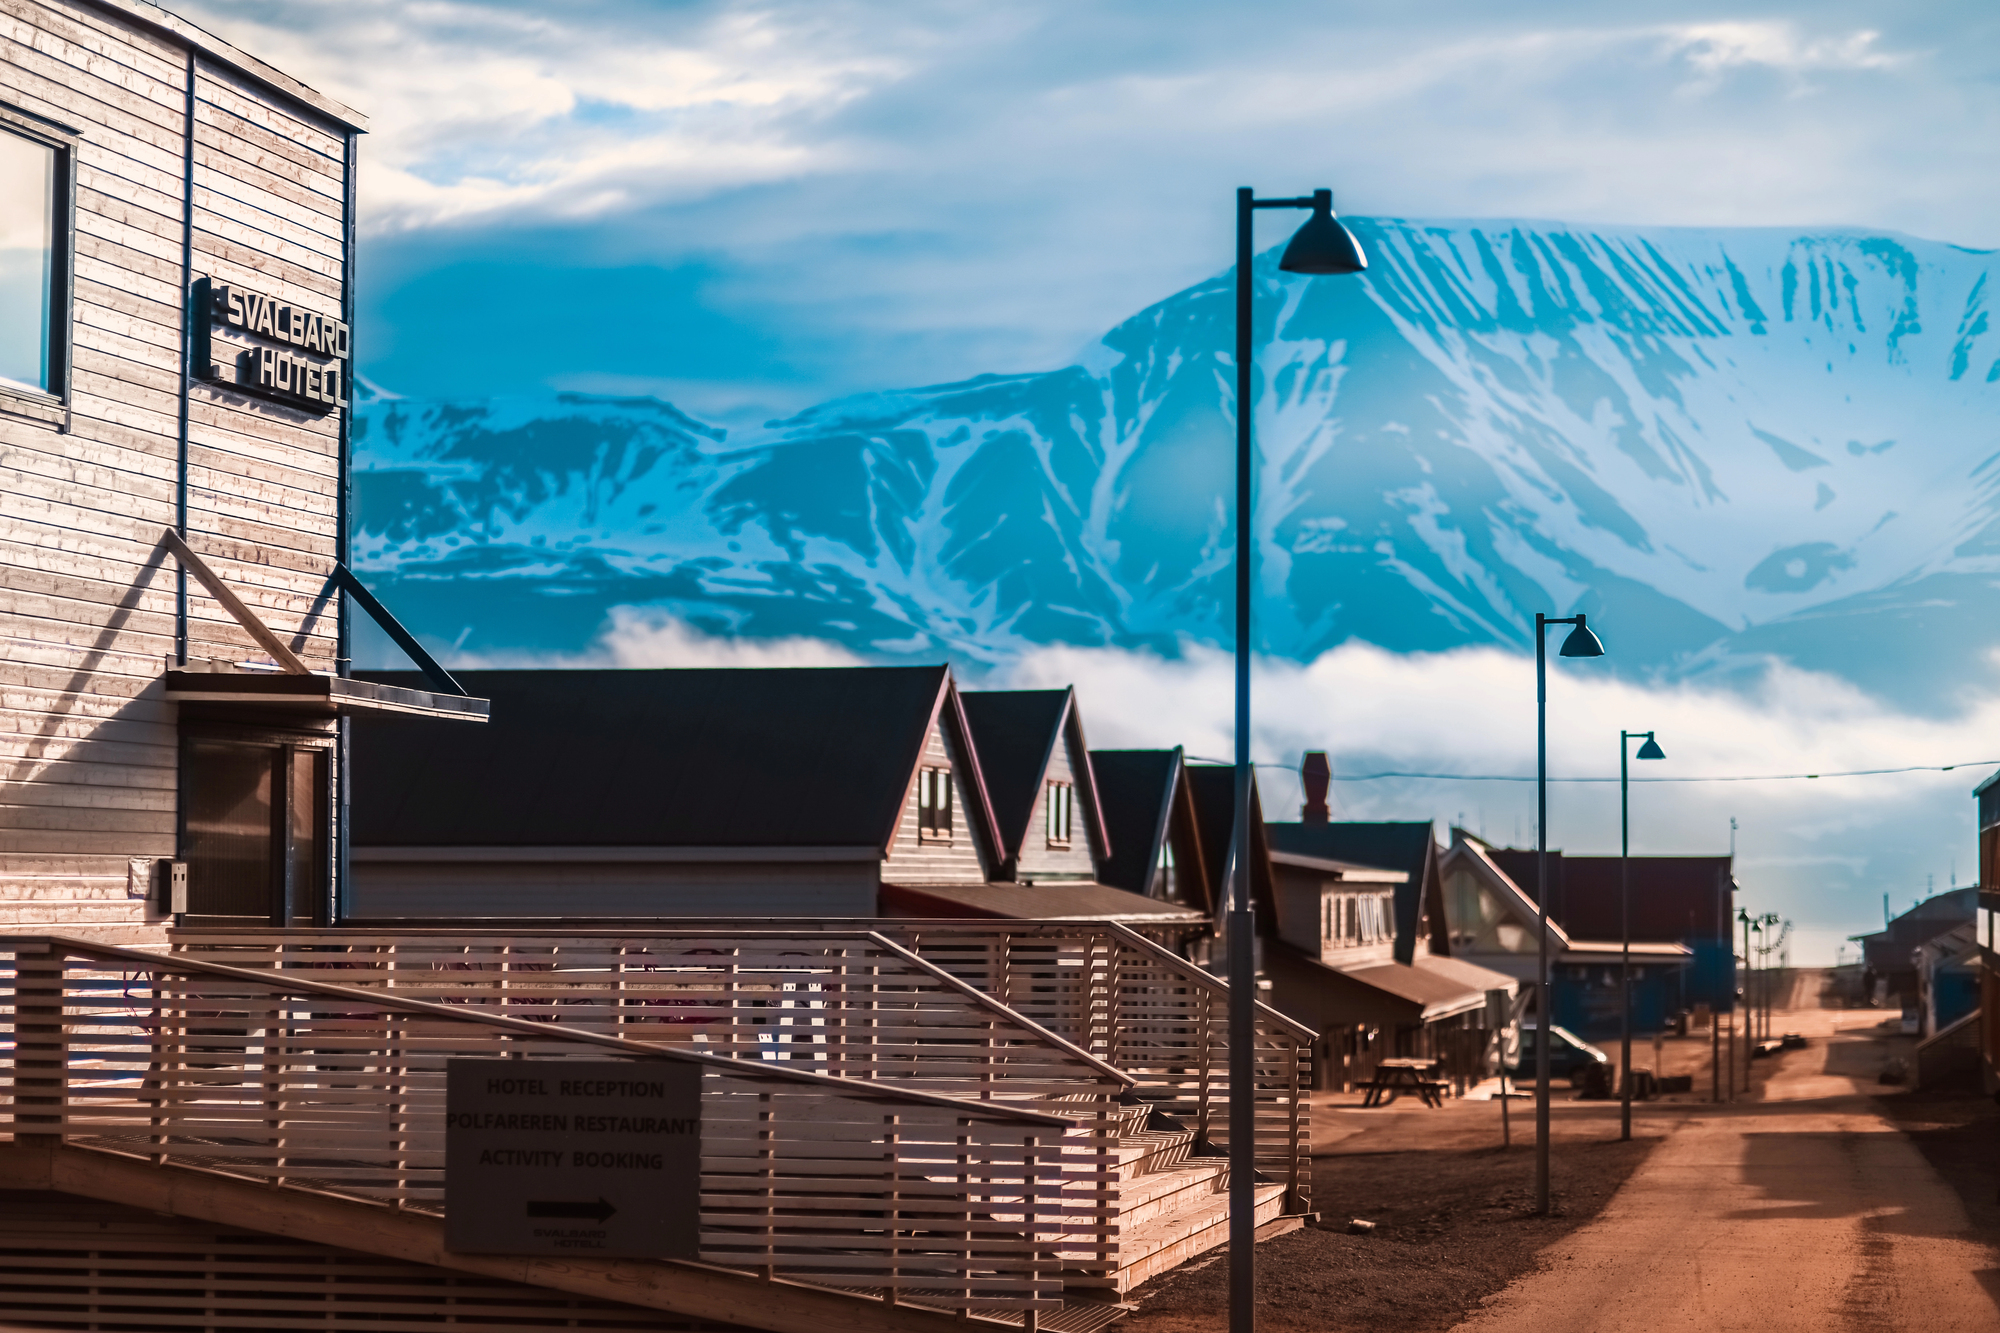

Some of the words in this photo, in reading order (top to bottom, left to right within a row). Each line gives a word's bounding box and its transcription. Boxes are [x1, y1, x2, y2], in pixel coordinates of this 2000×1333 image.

[227, 286, 349, 360] SVALBARD
[260, 347, 349, 409] HOTELL
[487, 1078, 548, 1096] HOTEL
[560, 1080, 664, 1099] RECEPTION
[447, 1113, 567, 1132] POLFAREREN
[574, 1115, 697, 1135] RESTAURANT
[479, 1149, 563, 1167] ACTIVITY
[573, 1151, 663, 1170] BOOKING
[533, 1228, 606, 1239] SVALBARD
[553, 1239, 606, 1249] HOTELL
